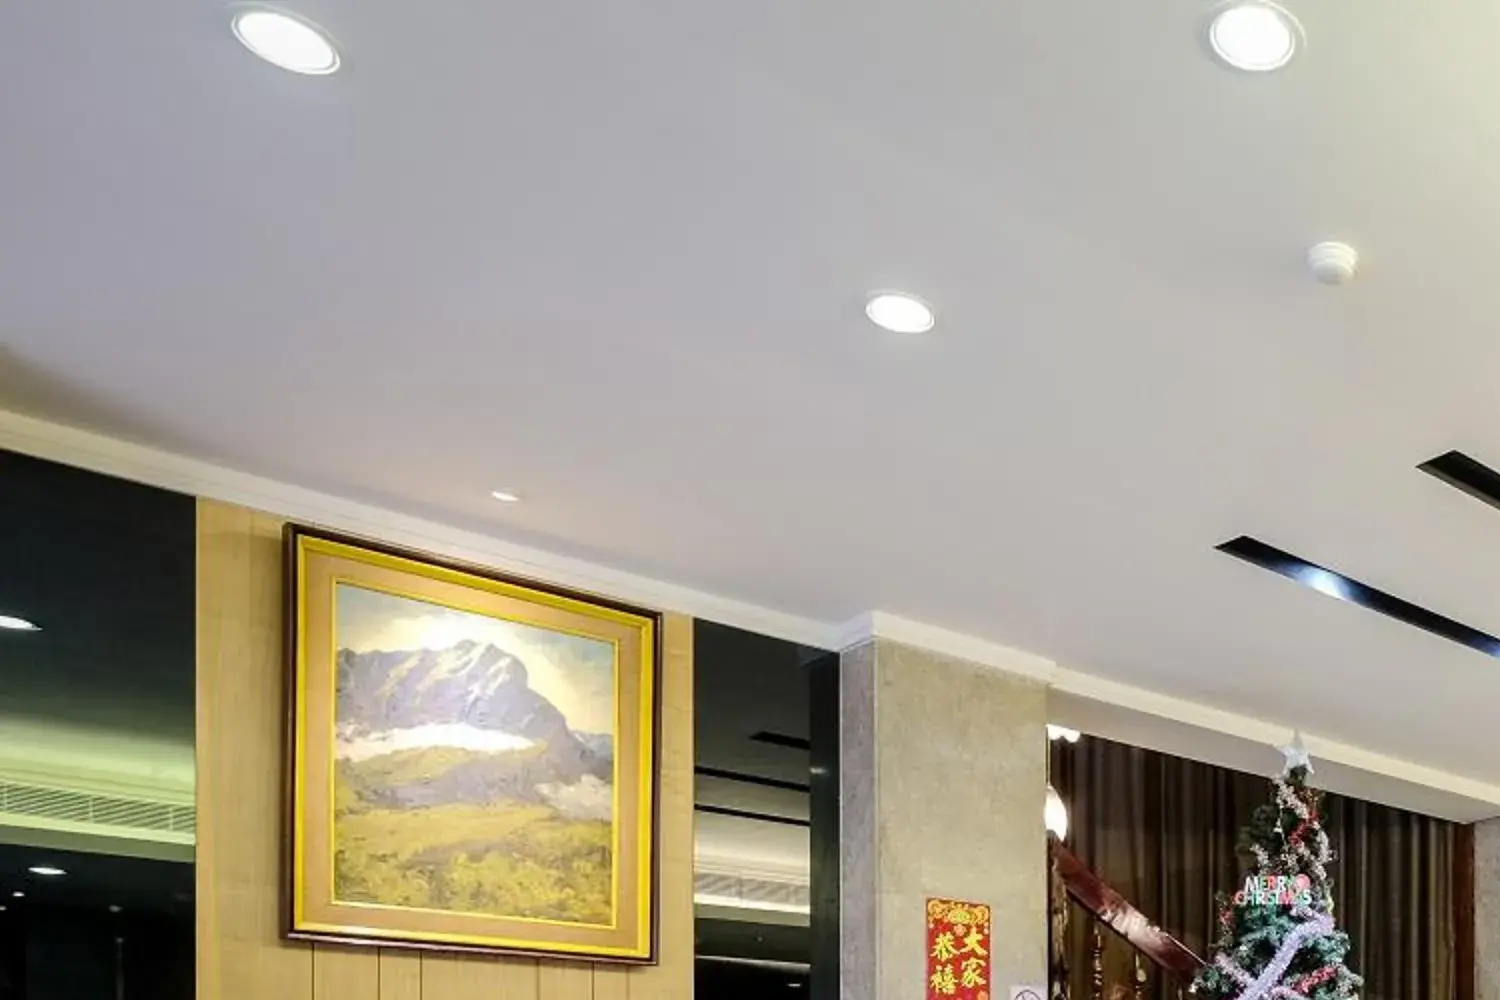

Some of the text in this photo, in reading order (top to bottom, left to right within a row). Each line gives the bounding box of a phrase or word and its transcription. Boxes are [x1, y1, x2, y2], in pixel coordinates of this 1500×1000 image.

[1245, 876, 1295, 892] MERRY
[1234, 889, 1313, 906] CHRISTMAS
[960, 925, 988, 989] 大家
